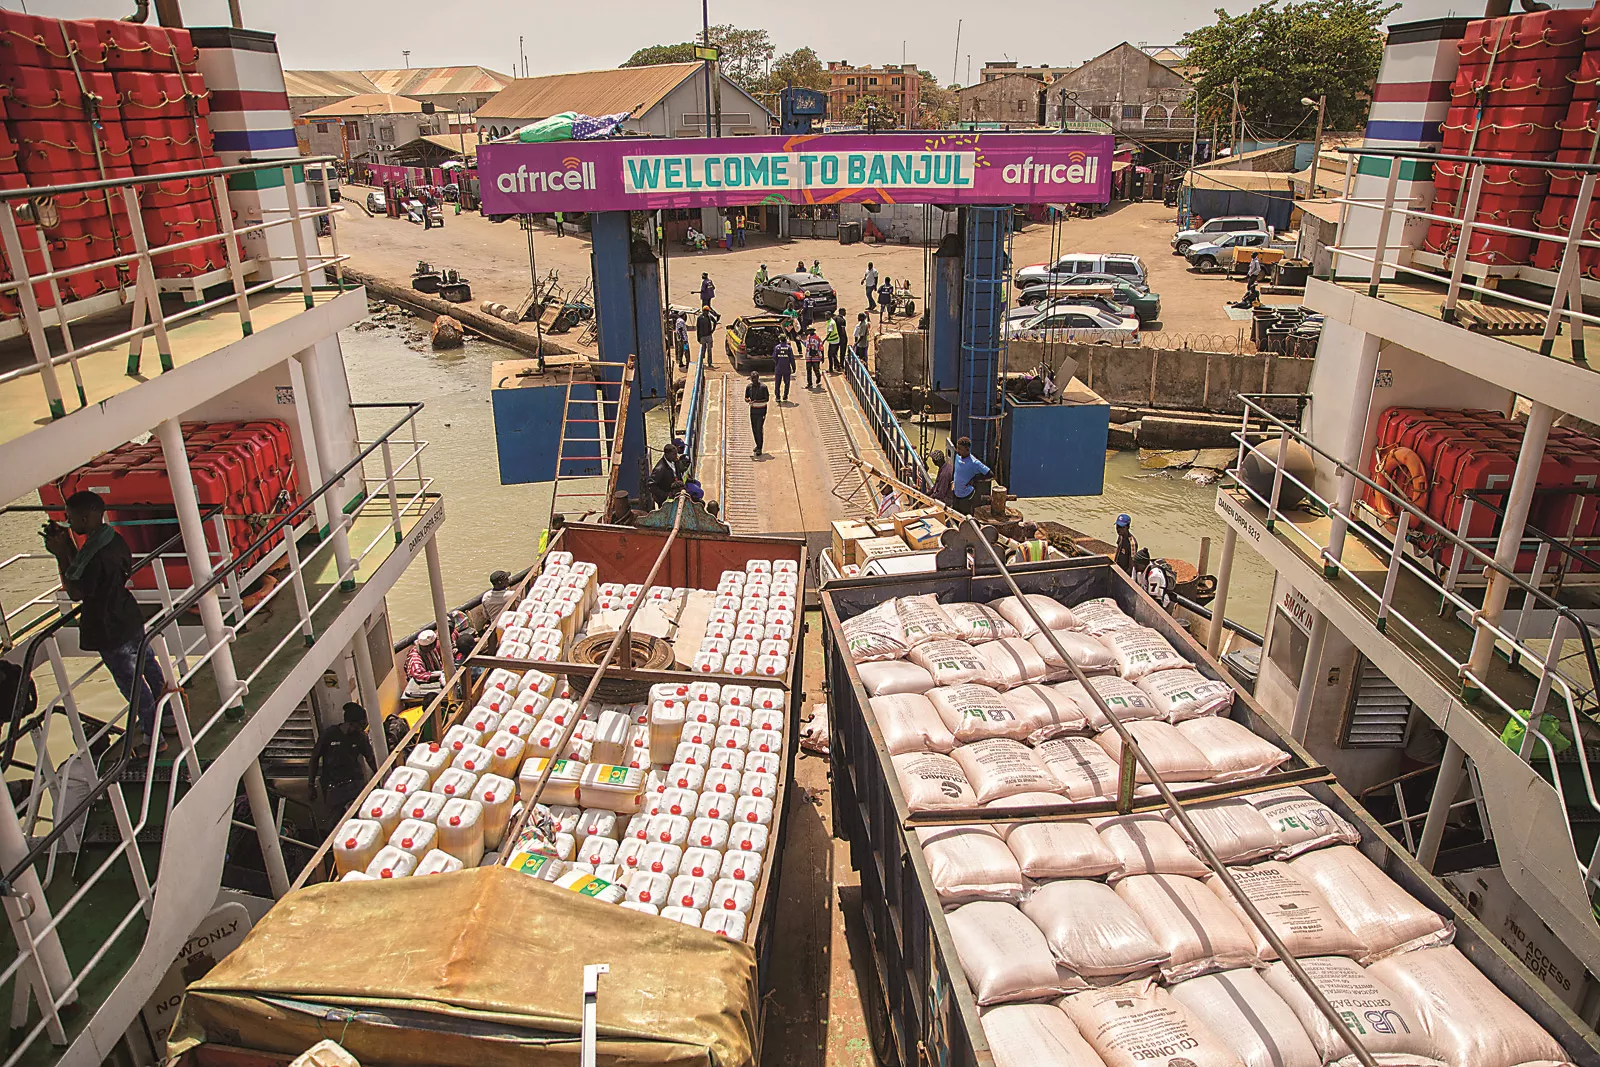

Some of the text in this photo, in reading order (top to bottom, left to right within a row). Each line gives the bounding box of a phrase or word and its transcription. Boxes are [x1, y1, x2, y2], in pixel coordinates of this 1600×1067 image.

[496, 159, 597, 194] africell
[627, 153, 970, 190] WELCOME TO BANJUL
[1001, 155, 1099, 185] africell
[1218, 497, 1235, 517] DAMEN
[1247, 525, 1261, 542] 5212
[408, 529, 424, 552] DAMEN
[1149, 582, 1158, 592] 7
[1283, 592, 1314, 631] SMOKIN
[1230, 869, 1280, 881] OLOMBO
[197, 919, 240, 949] ONLY
[1524, 951, 1547, 982] FOR
[1526, 940, 1571, 991] ACCESS
[156, 994, 182, 1015] NO
[1329, 998, 1391, 1009] GRUPO BAZ
[1131, 1037, 1199, 1061] COLOMBO
